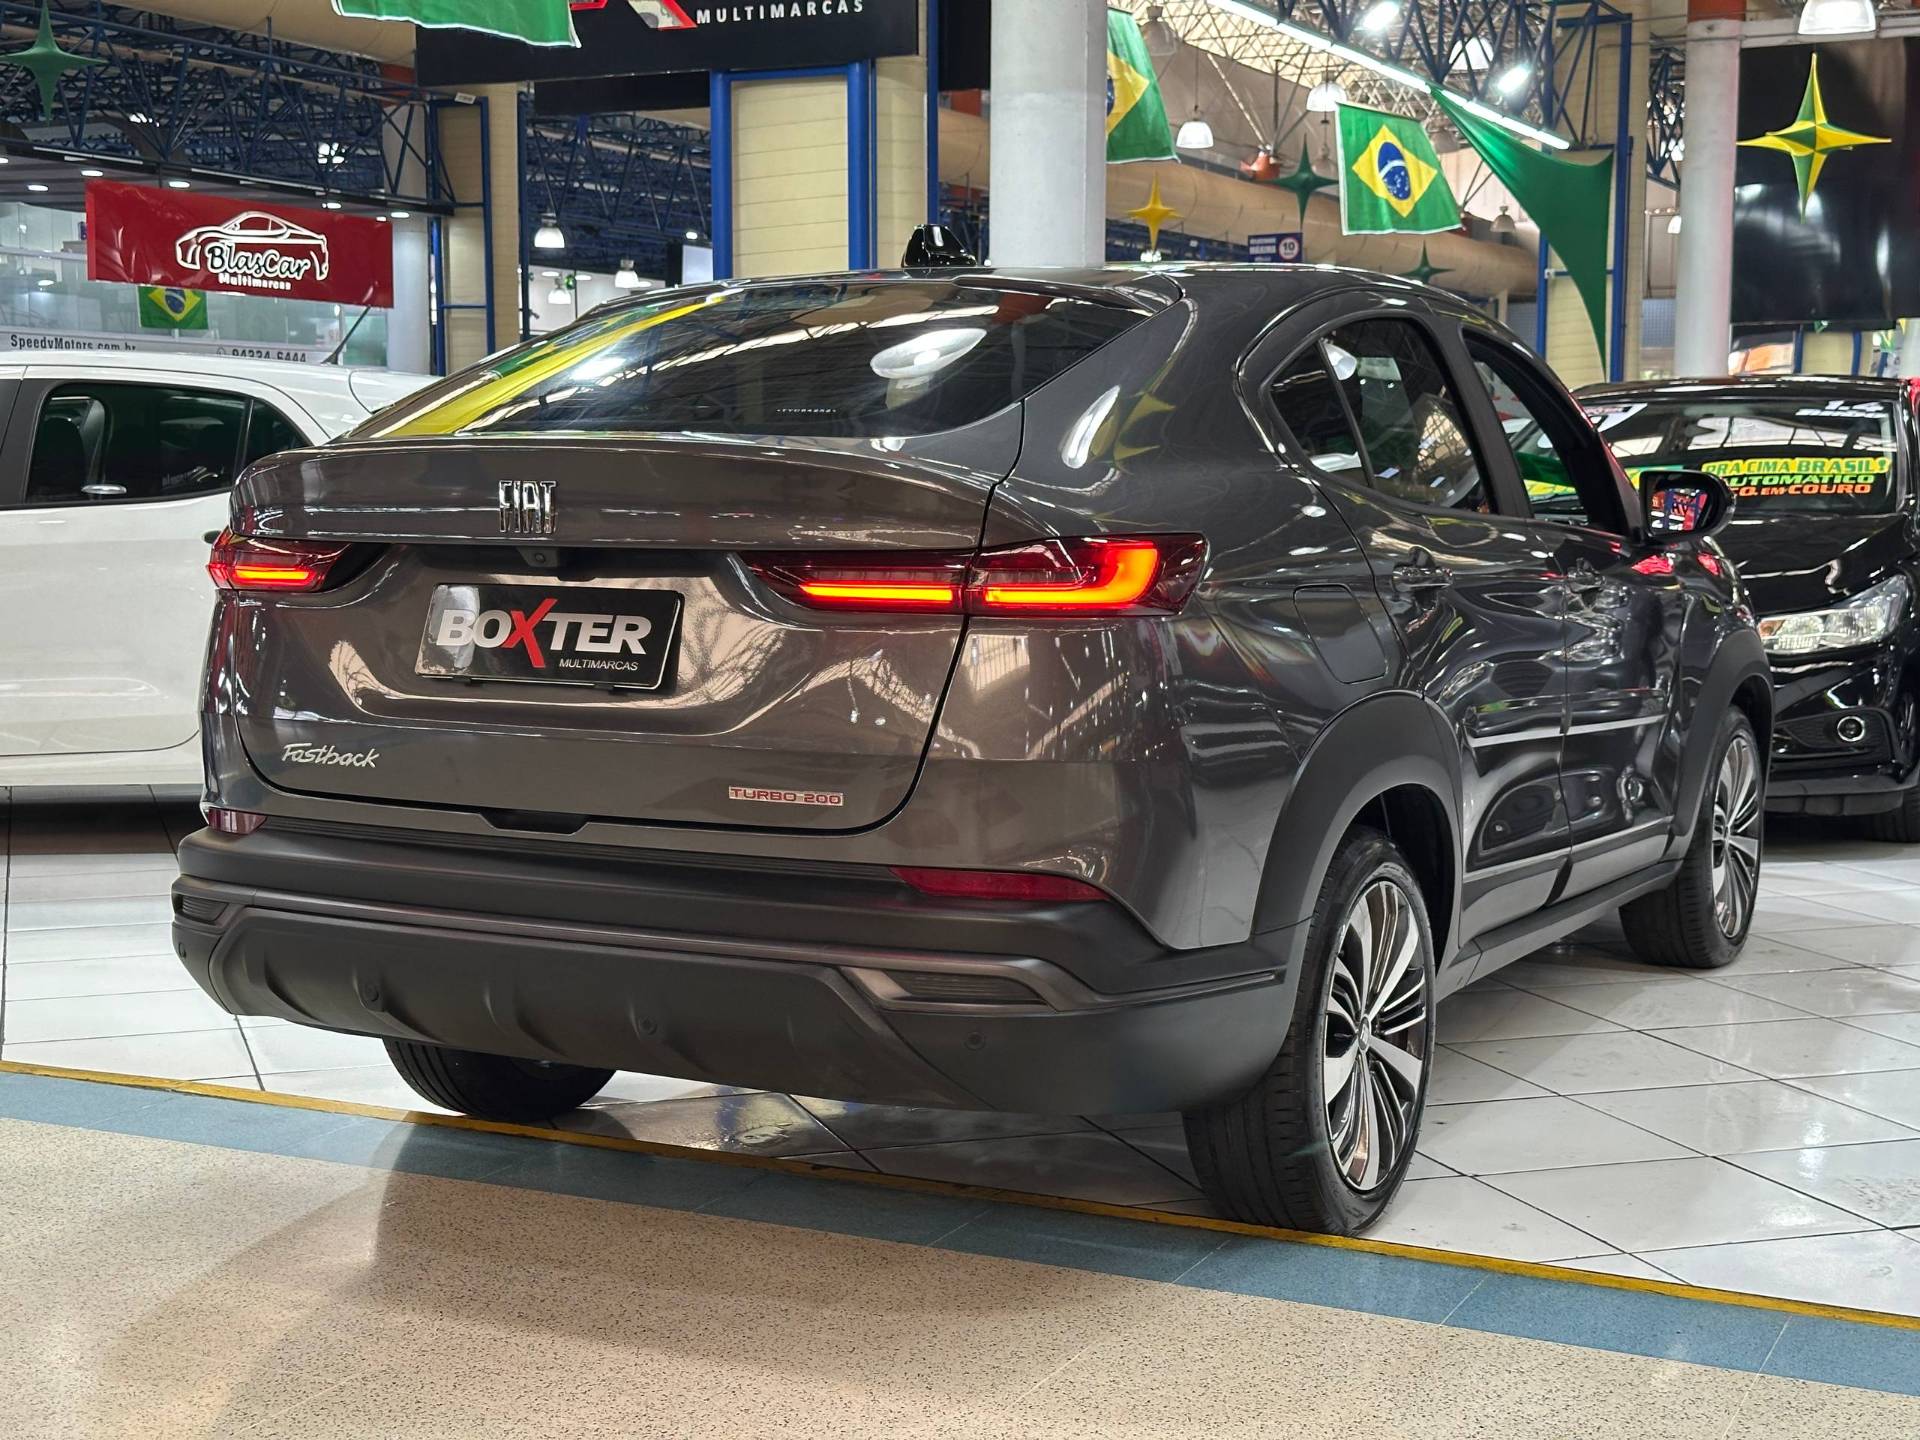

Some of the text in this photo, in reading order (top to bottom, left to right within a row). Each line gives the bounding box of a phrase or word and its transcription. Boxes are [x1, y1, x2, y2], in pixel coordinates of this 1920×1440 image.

[696, 0, 863, 24] MULTIMARCAS
[1283, 241, 1296, 251] 10
[206, 243, 311, 279] BlasCar
[1703, 461, 1742, 475] PRA
[1745, 458, 1792, 474] CIMA
[1787, 484, 1872, 495] COURO
[499, 480, 557, 534] FIAT
[436, 598, 652, 669] BOXTER
[559, 658, 639, 671] MULTIMARCAS
[281, 742, 380, 768] Fastback
[730, 787, 842, 805] TURBO 200
